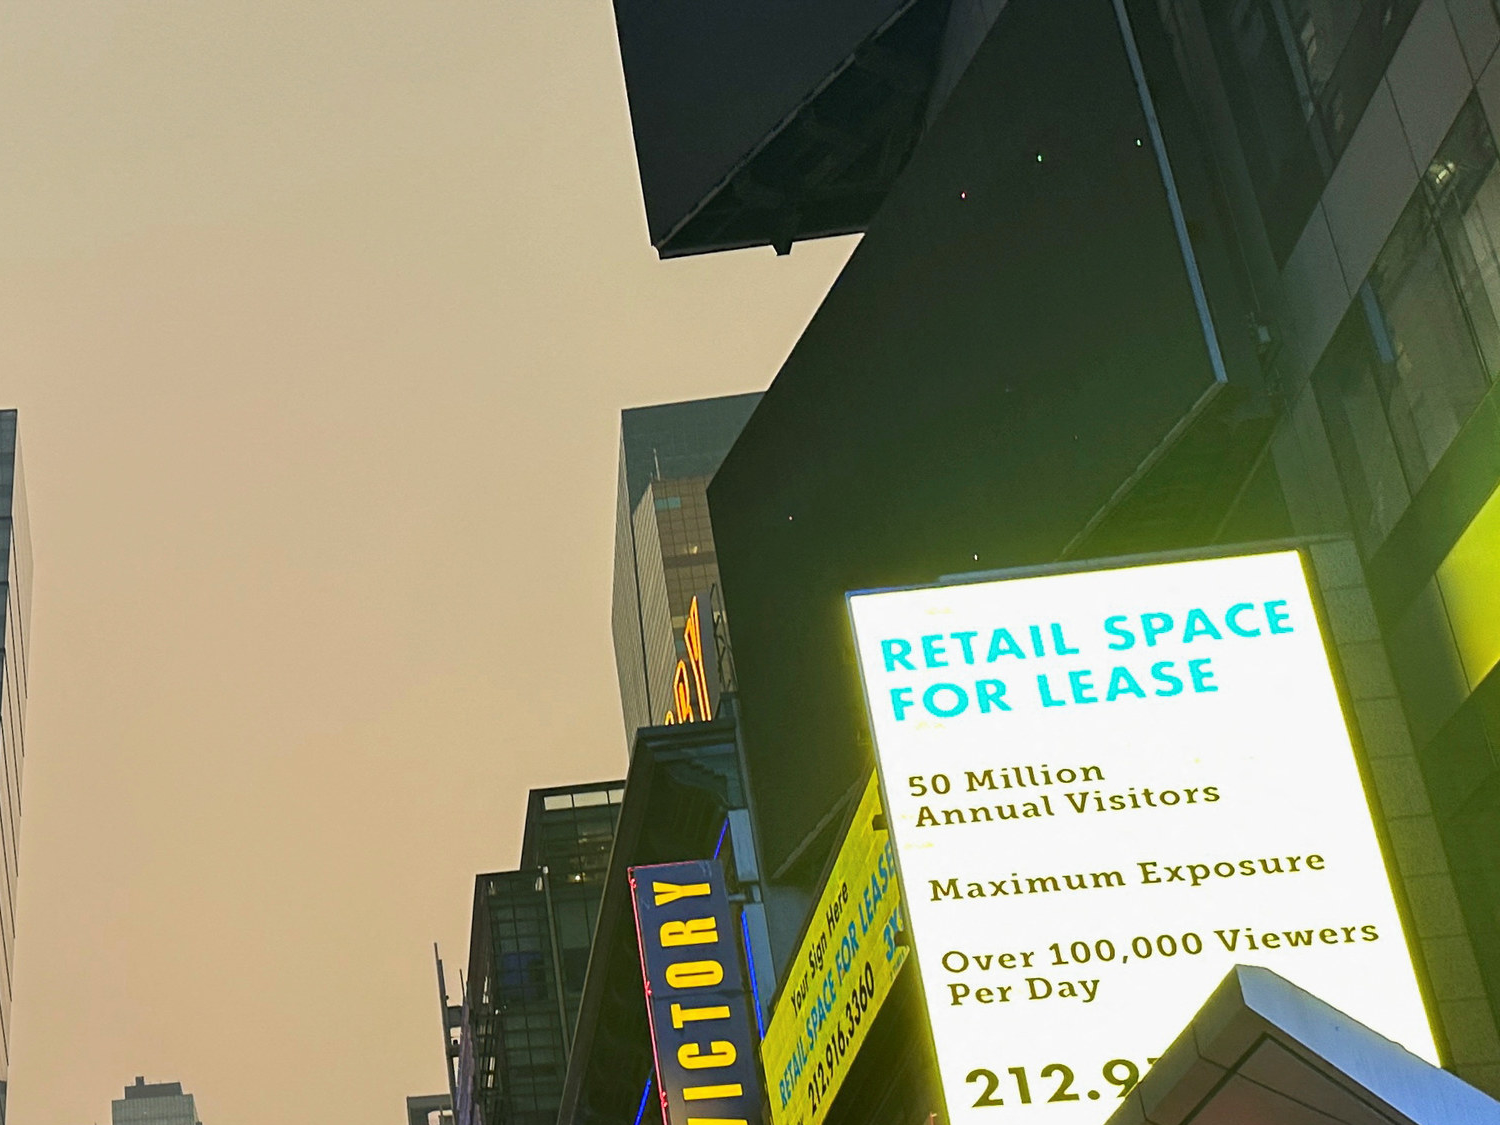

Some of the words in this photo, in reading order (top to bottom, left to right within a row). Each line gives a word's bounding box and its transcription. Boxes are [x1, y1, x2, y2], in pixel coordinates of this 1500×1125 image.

[880, 621, 1080, 673] RETAIL
[1103, 599, 1296, 653] SPACE
[888, 676, 1013, 722] FOR
[1037, 657, 1220, 710] LEASE
[908, 772, 951, 798] 50
[965, 761, 1106, 792] Million
[914, 795, 1053, 828] Annual
[1065, 781, 1221, 815] Visitors
[928, 866, 1126, 902] Maximum
[1139, 849, 1326, 889] Exposure
[790, 982, 809, 1018] Your
[808, 936, 828, 972] Sign
[826, 882, 849, 931] Here
[942, 947, 1035, 974] Over
[1048, 931, 1204, 967] 100,000
[1213, 920, 1380, 953] Viewers
[779, 1037, 809, 1110] RETAIL
[806, 970, 837, 1050] SPACE
[835, 921, 860, 985] FOR
[859, 841, 896, 935] LEASE
[948, 978, 1013, 1006] Per
[1027, 975, 1100, 1003] Day
[808, 961, 875, 1118] 212.916.3360
[965, 1057, 1160, 1108] 212.9
